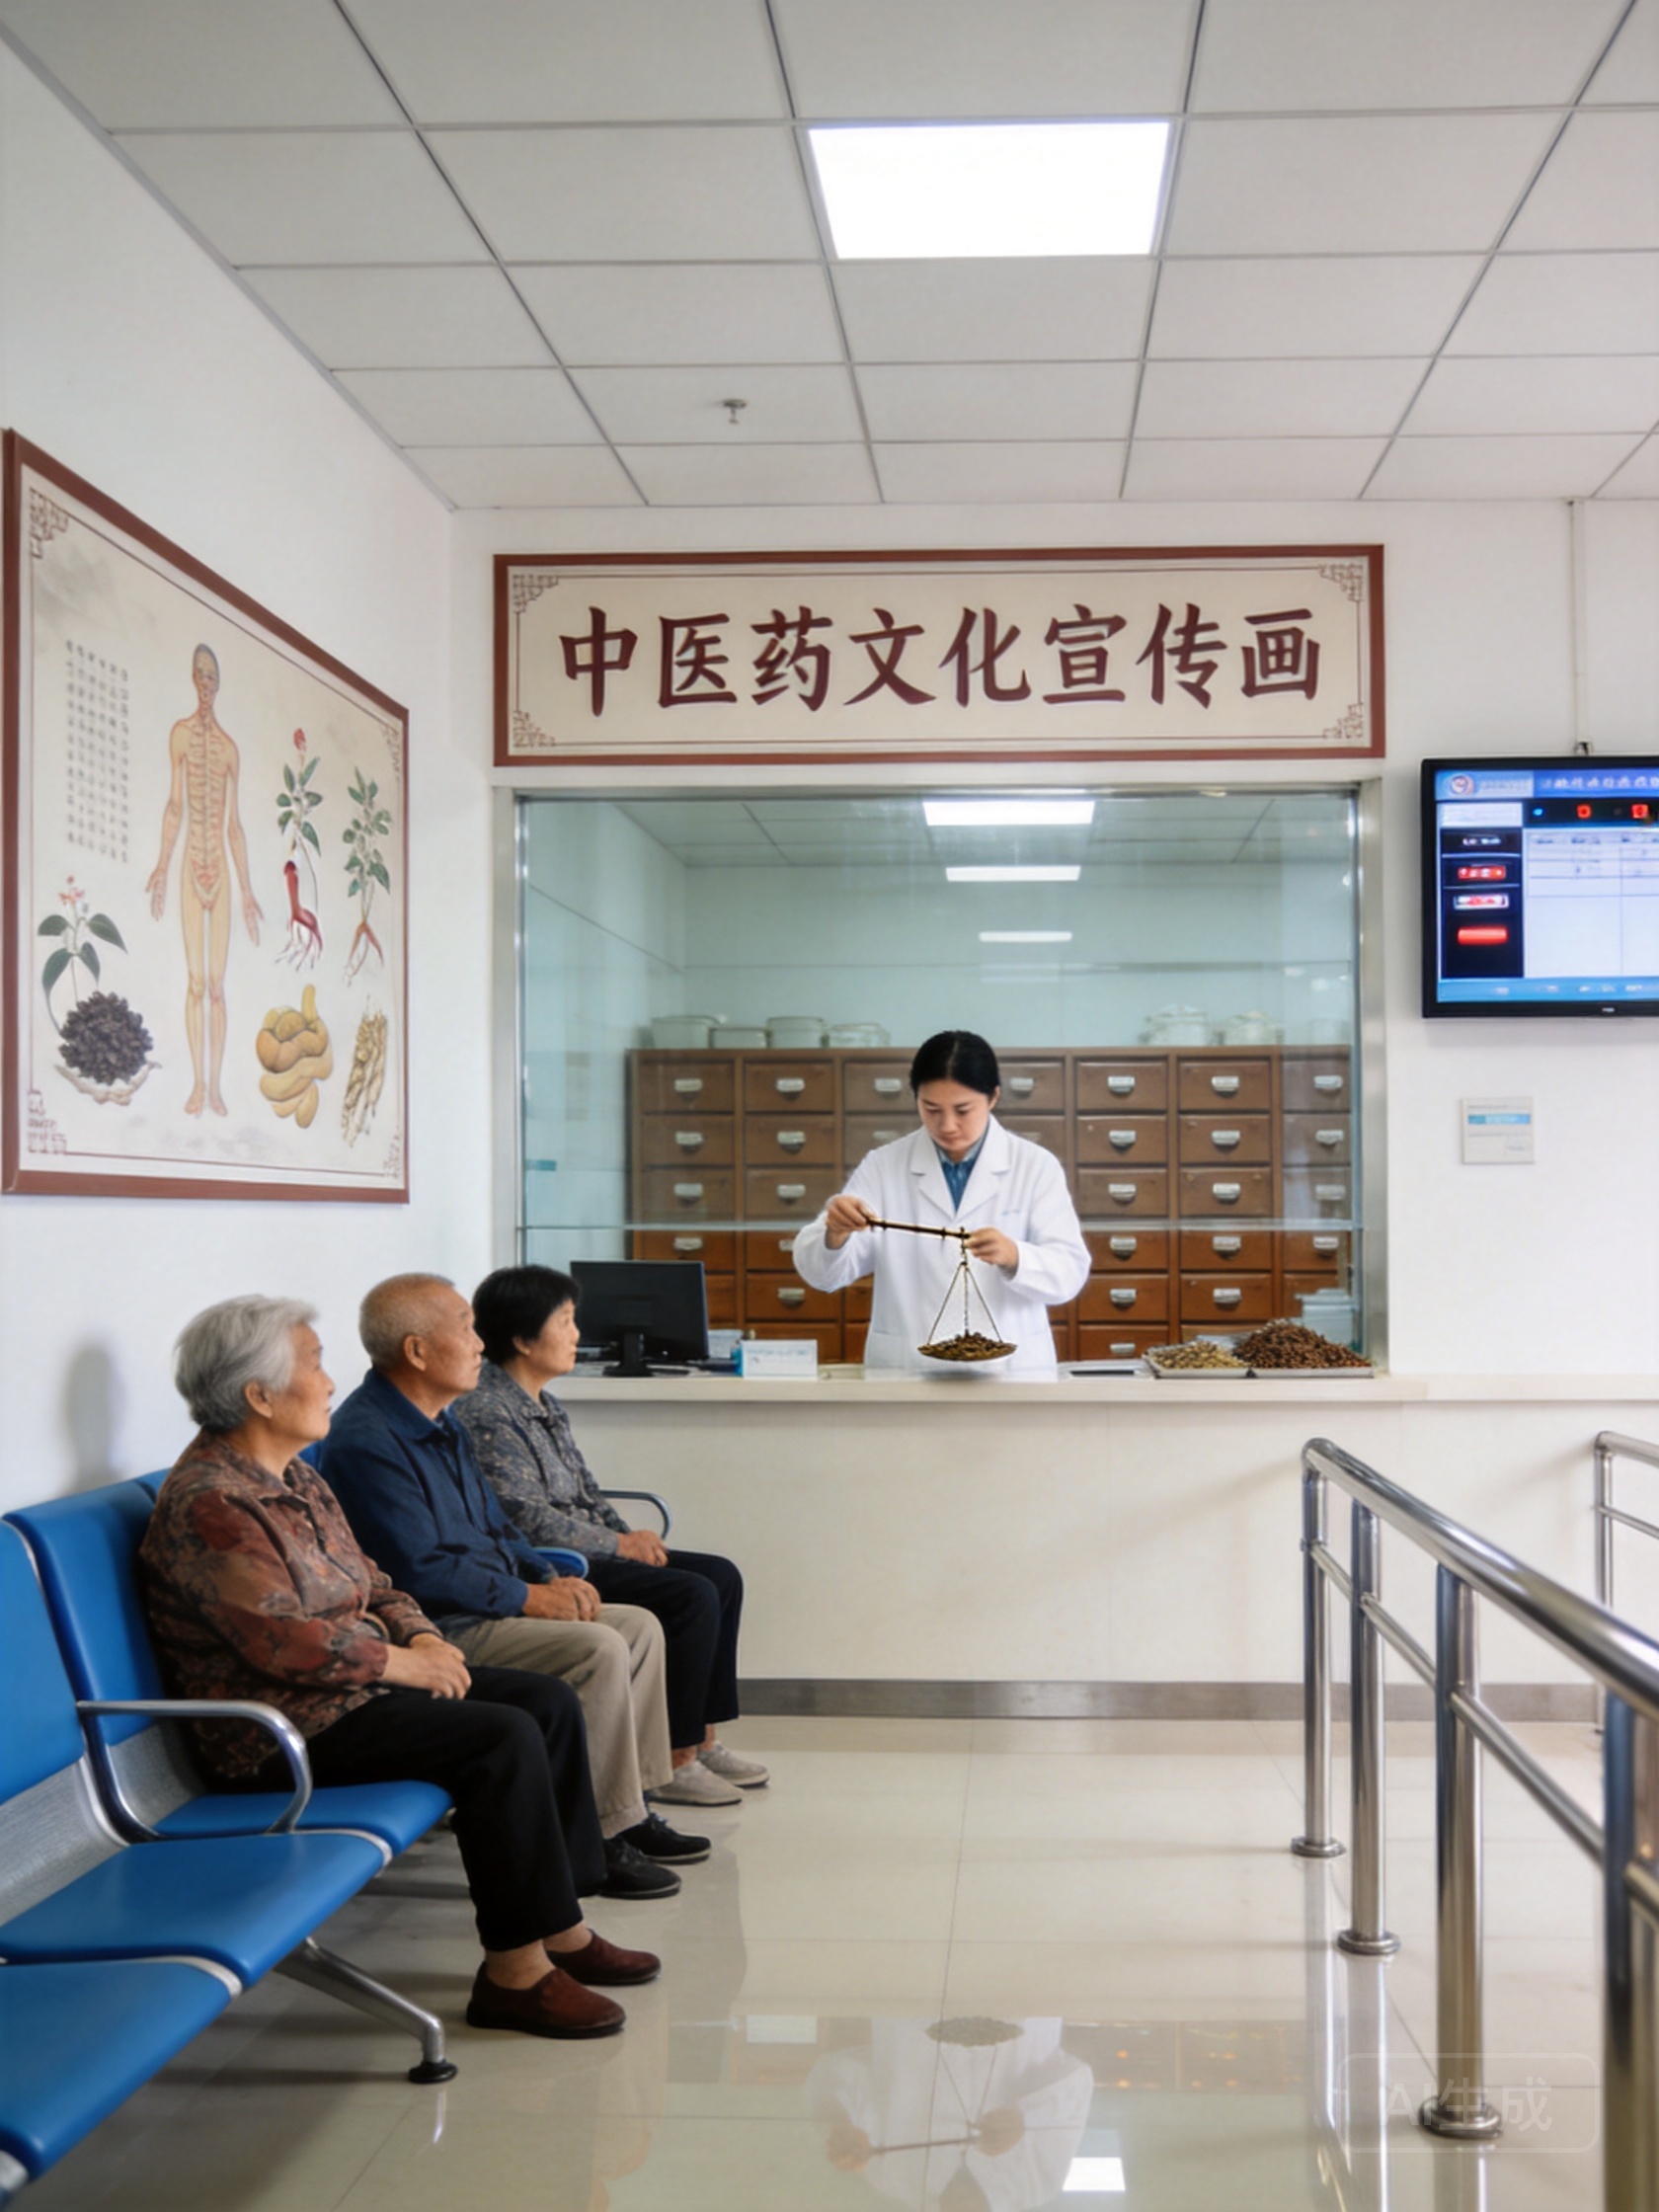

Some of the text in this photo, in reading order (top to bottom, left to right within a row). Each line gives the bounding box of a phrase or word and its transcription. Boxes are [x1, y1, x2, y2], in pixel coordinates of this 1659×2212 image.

[559, 603, 1321, 717] 中医药文化宣传画
